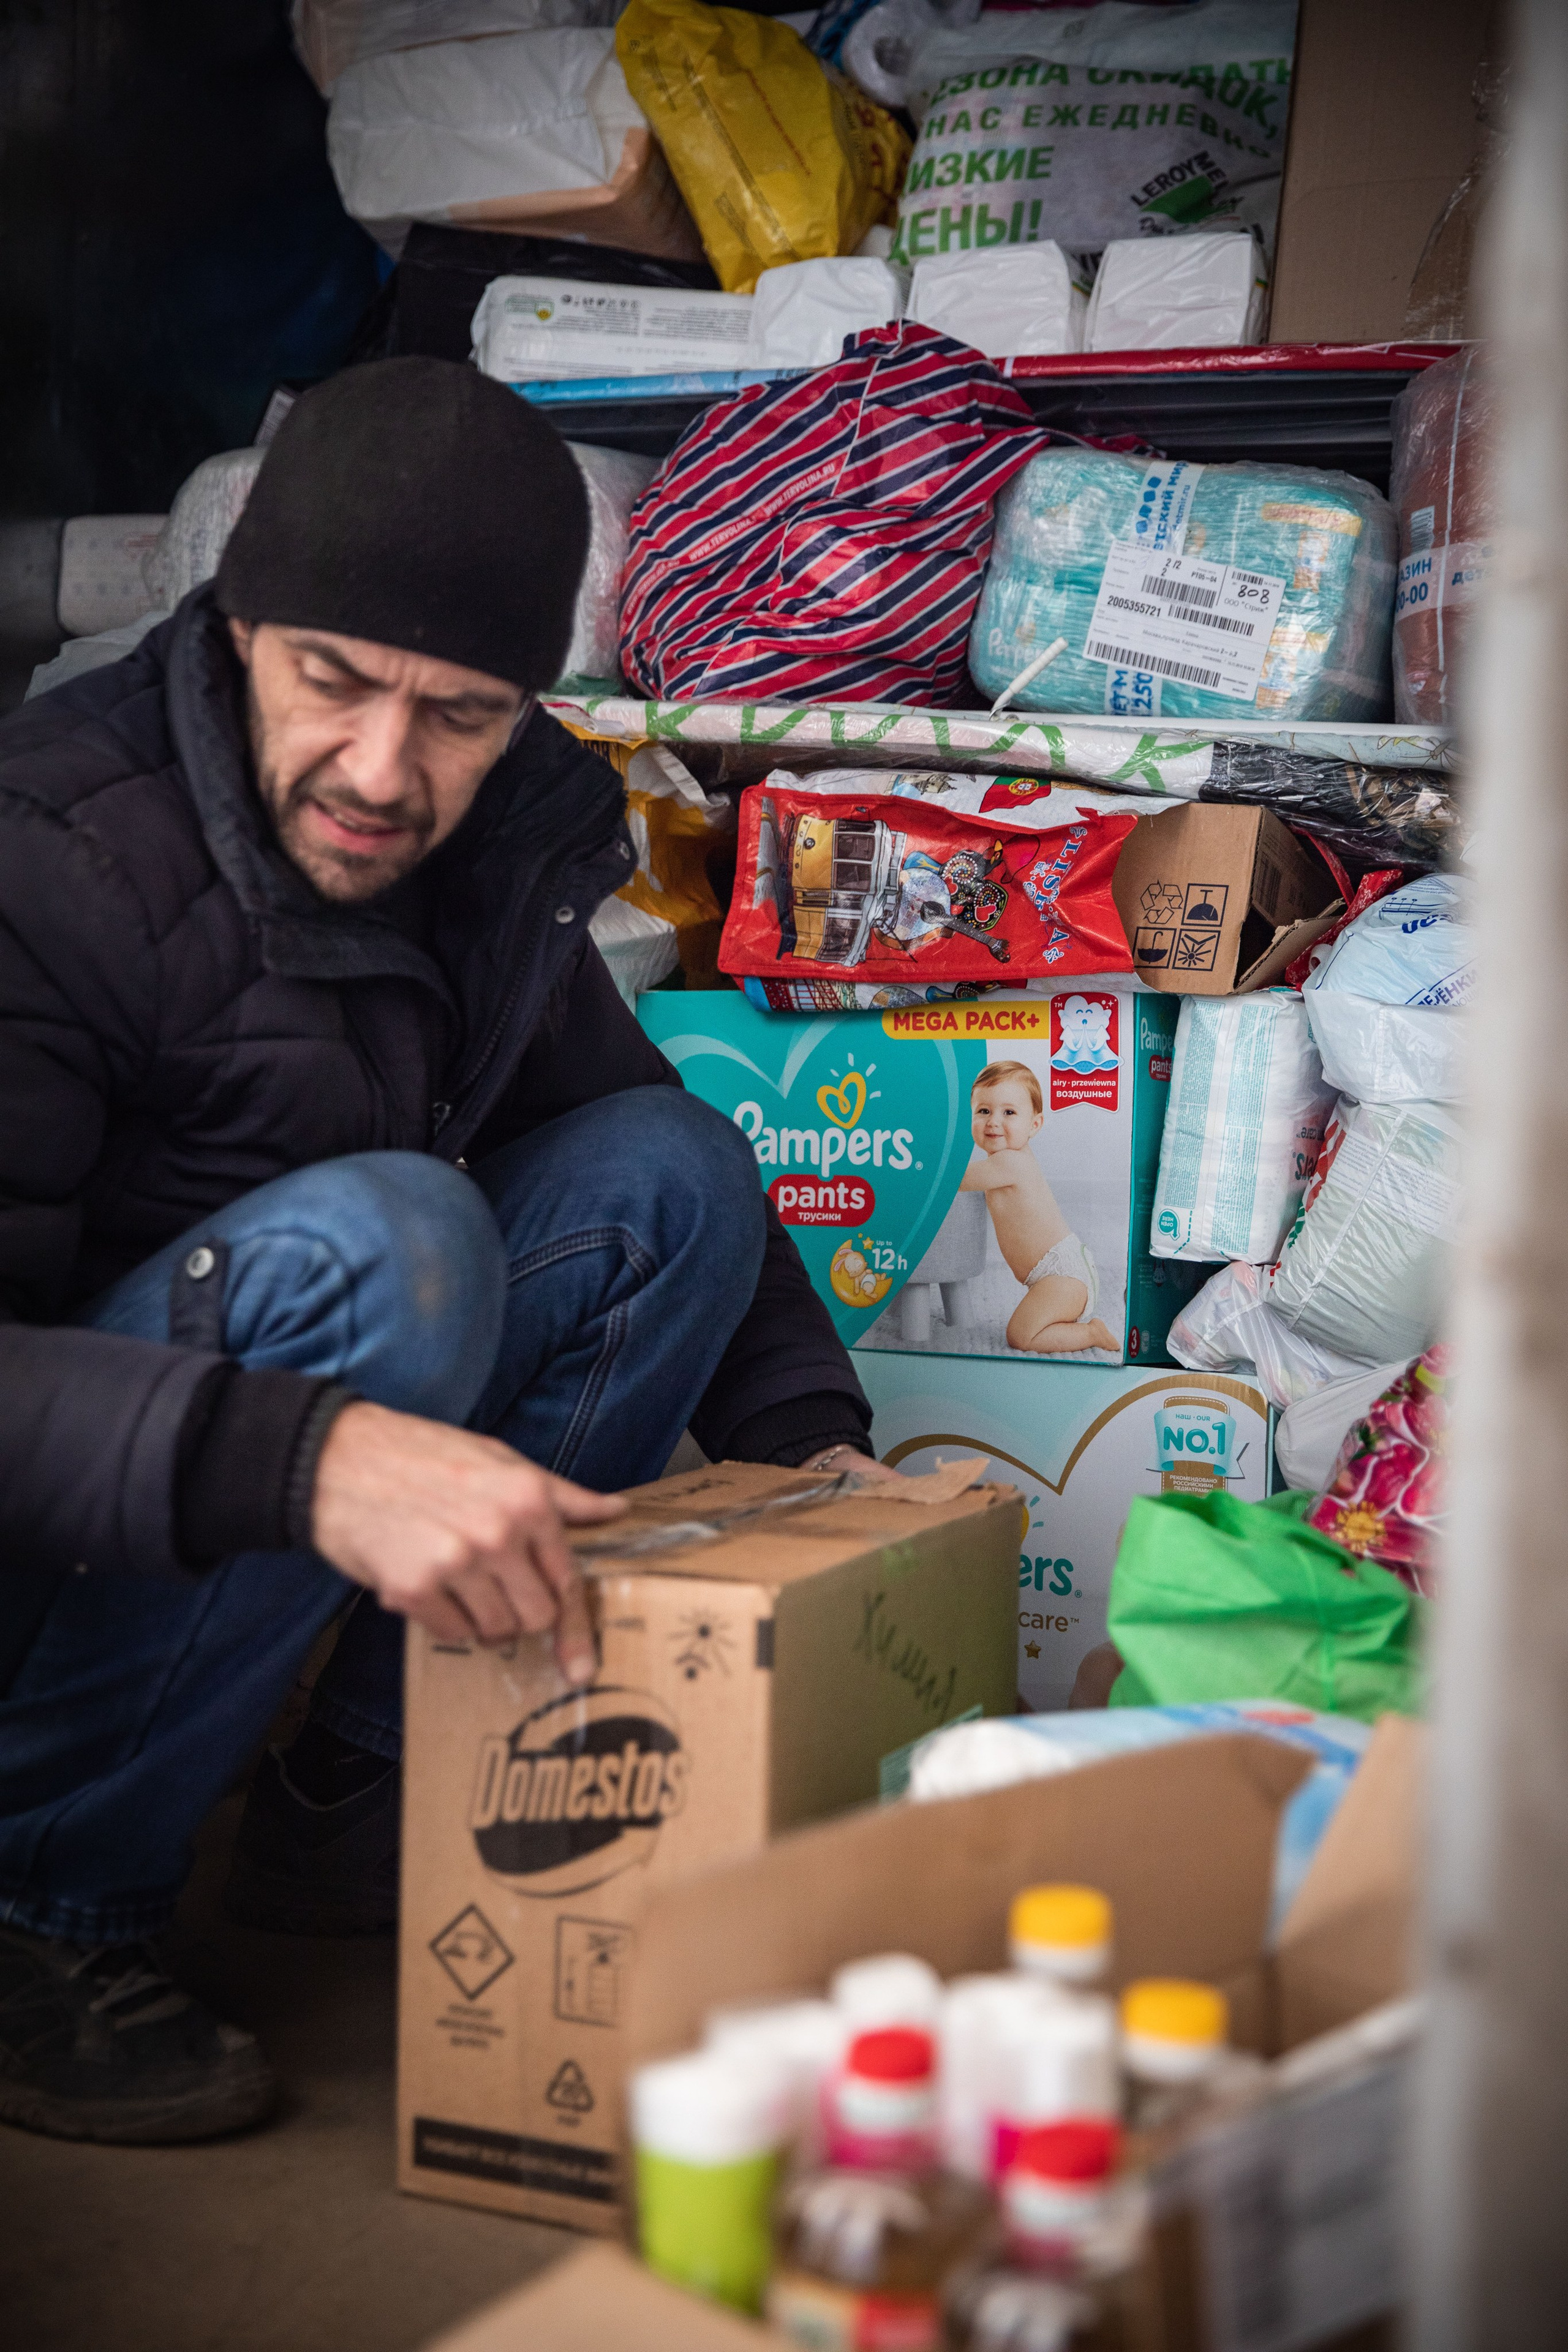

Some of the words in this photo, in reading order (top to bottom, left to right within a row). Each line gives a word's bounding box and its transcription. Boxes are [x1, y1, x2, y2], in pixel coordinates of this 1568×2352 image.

[1131, 157, 1197, 206] LEROY
[1238, 584, 1270, 604] 808
[1107, 595, 1162, 617] 2005355721
[893, 1011, 959, 1031] MEGA
[965, 1011, 1040, 1031] PACK+
[1052, 1079, 1067, 1088] airy
[1071, 1079, 1116, 1088] przewiewna
[1056, 1090, 1112, 1100] воздушные
[778, 1182, 866, 1213] pants
[797, 1212, 842, 1223] трусики
[1131, 1329, 1137, 1349] 3
[1163, 1422, 1226, 1455] NO.1
[1169, 1475, 1218, 1484] РЕКОМЕНДОВАНО
[1173, 1480, 1214, 1489] РОССИЙСКИМИ
[1019, 1554, 1074, 1597] ers
[470, 1737, 682, 1830] Domestos
